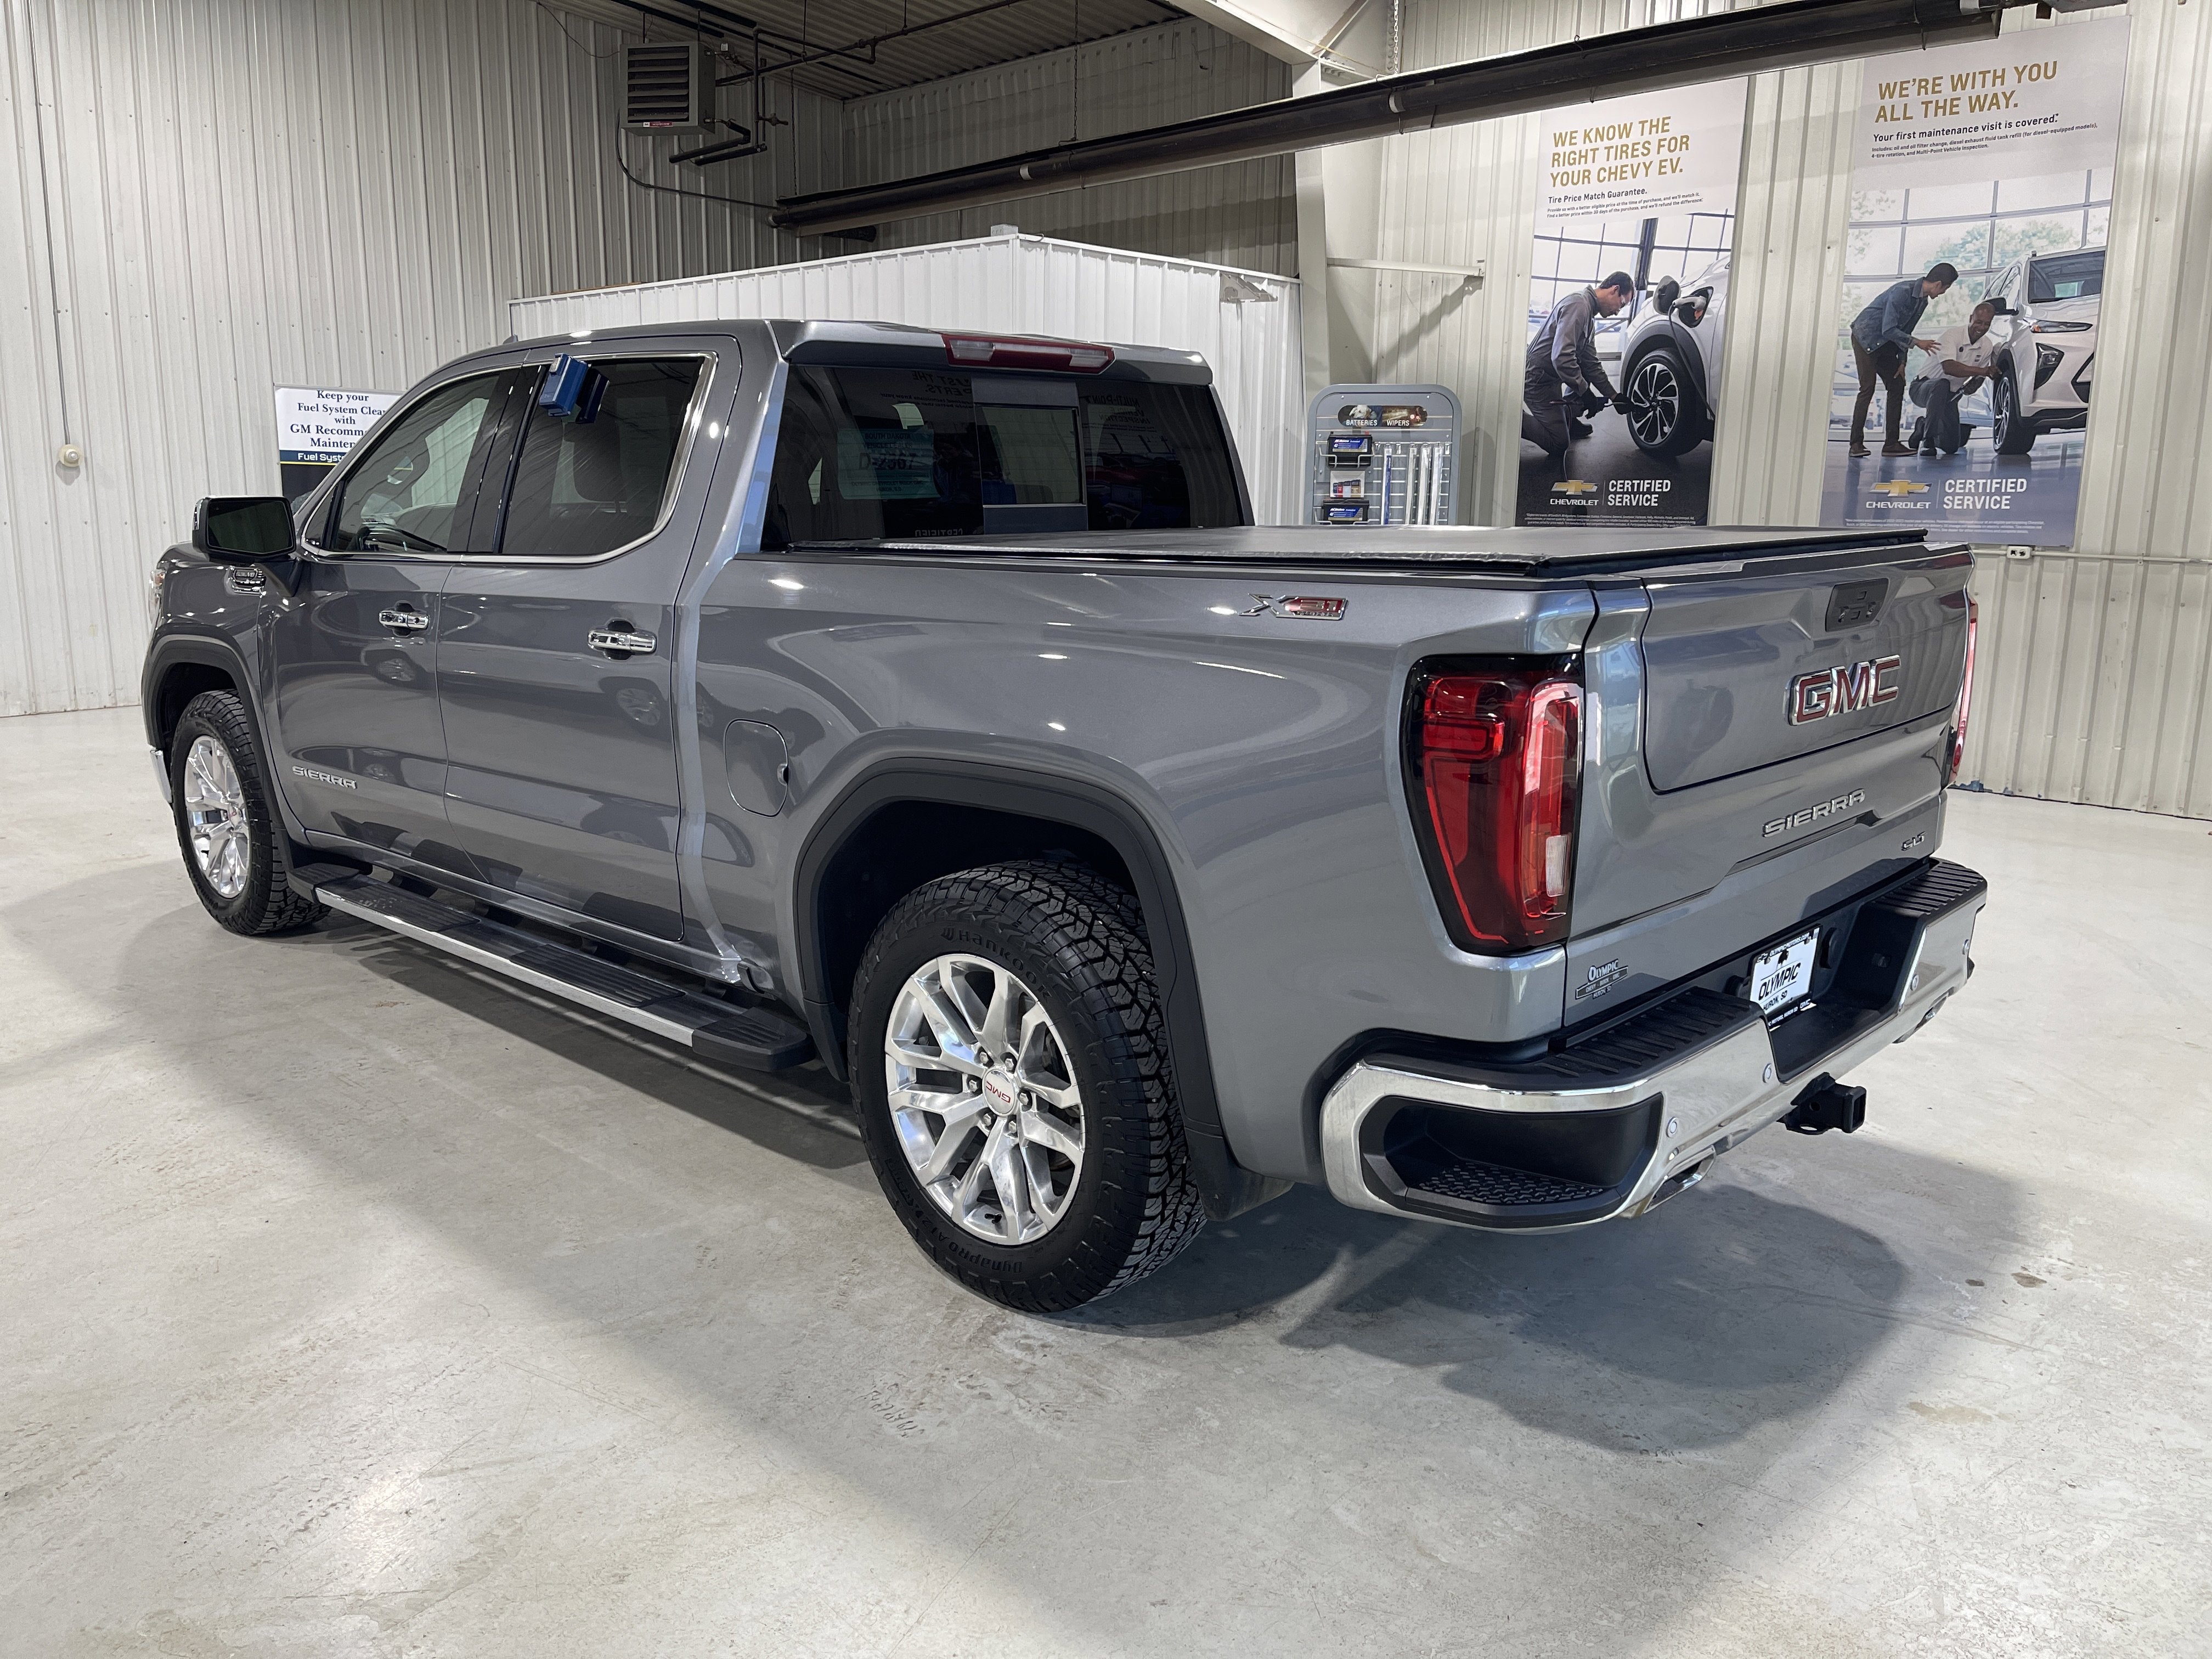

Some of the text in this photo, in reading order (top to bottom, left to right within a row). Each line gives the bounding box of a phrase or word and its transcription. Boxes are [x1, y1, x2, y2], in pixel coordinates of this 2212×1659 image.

[1878, 60, 2058, 100] WE'RE WITH YOU
[1875, 90, 2019, 123] ALL THE WAY.
[1553, 116, 1671, 147] WE KNOW THE
[1897, 131, 1916, 140] first
[1919, 126, 1979, 138] maintenance
[1981, 122, 2002, 132] visit
[2005, 120, 2013, 129] is
[1551, 135, 1690, 167] RIGHT TIRES FOR
[1550, 157, 1683, 188] YOUR CHEVY EV.
[1584, 192, 1605, 201] Match
[1607, 188, 1647, 198] Guarantee.
[317, 390, 369, 403] Keep your
[298, 403, 319, 412] Fuel
[323, 404, 357, 415] System
[290, 424, 311, 433] GM
[334, 416, 356, 425] with
[298, 453, 317, 461] Fuel
[1609, 479, 1671, 492] CERTIFIED
[1945, 478, 2027, 493] CERTIFIED
[1607, 494, 1659, 506] SERVICE
[1943, 495, 2011, 509] SERVICE
[1788, 654, 1901, 726] GMC
[292, 766, 357, 789] SIERRA
[1762, 788, 1866, 837] SIERRA
[1901, 832, 1926, 851] SLT
[1758, 963, 1801, 1000] OLYMPIC
[1763, 990, 1788, 1011] HURON, SD
[986, 1081, 1011, 1103] GMC
